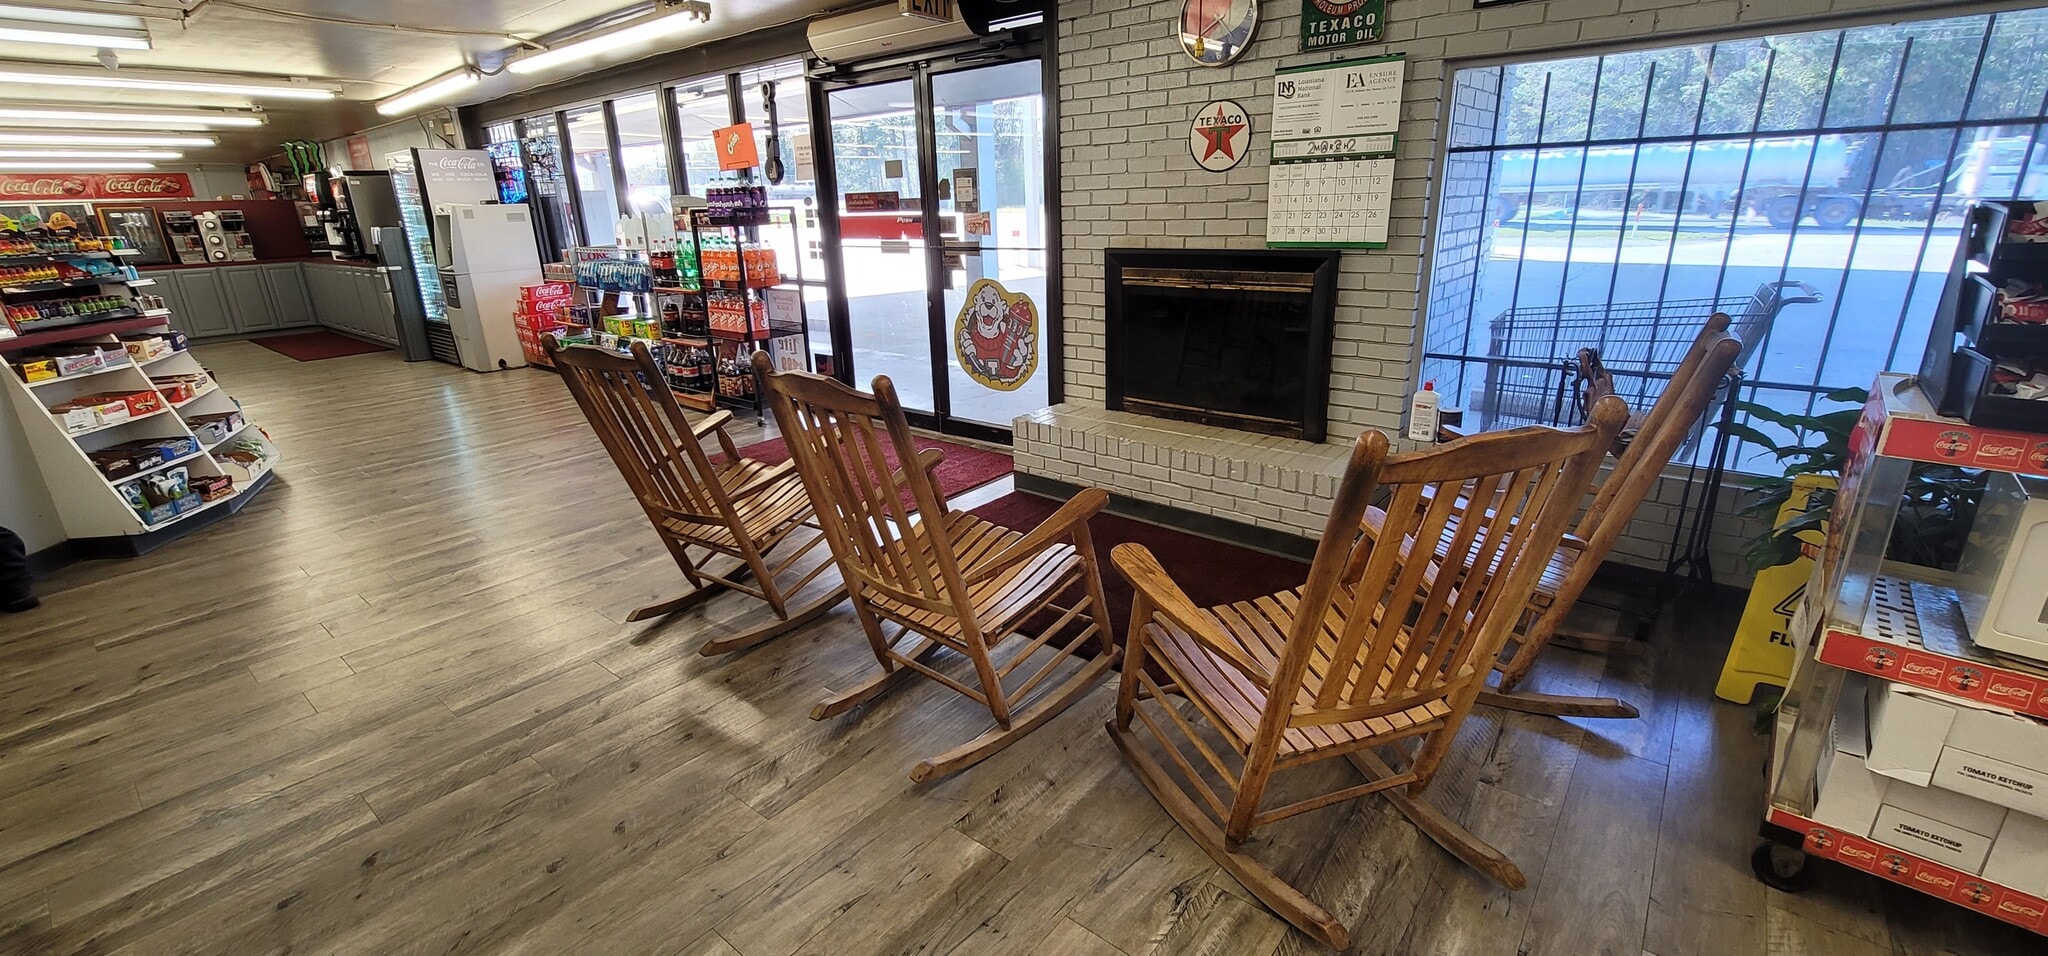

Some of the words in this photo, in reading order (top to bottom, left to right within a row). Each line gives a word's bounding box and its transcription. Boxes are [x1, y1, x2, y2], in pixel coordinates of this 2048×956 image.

[1309, 12, 1376, 34] TEXACO
[1308, 32, 1347, 47] MOTOR
[1356, 28, 1374, 40] OIL
[1298, 77, 1325, 86] Louisiana
[1368, 76, 1398, 85] AGENCY
[1369, 70, 1398, 79] ENSURE
[1297, 84, 1322, 93] National
[1200, 114, 1242, 127] TEXACO
[727, 132, 740, 155] Crush
[440, 156, 477, 170] Coca-Cola
[0, 178, 64, 195] Coca-Cola
[105, 177, 163, 194] Coca-Cola
[535, 285, 564, 298] Coca-Cola
[1981, 444, 2018, 456] Coca-Cola
[1962, 765, 1997, 780] TOMATO
[1998, 775, 2034, 790] KETCHUP
[1899, 823, 1930, 837] TOMATO
[1930, 831, 1962, 848] KETCHUP
